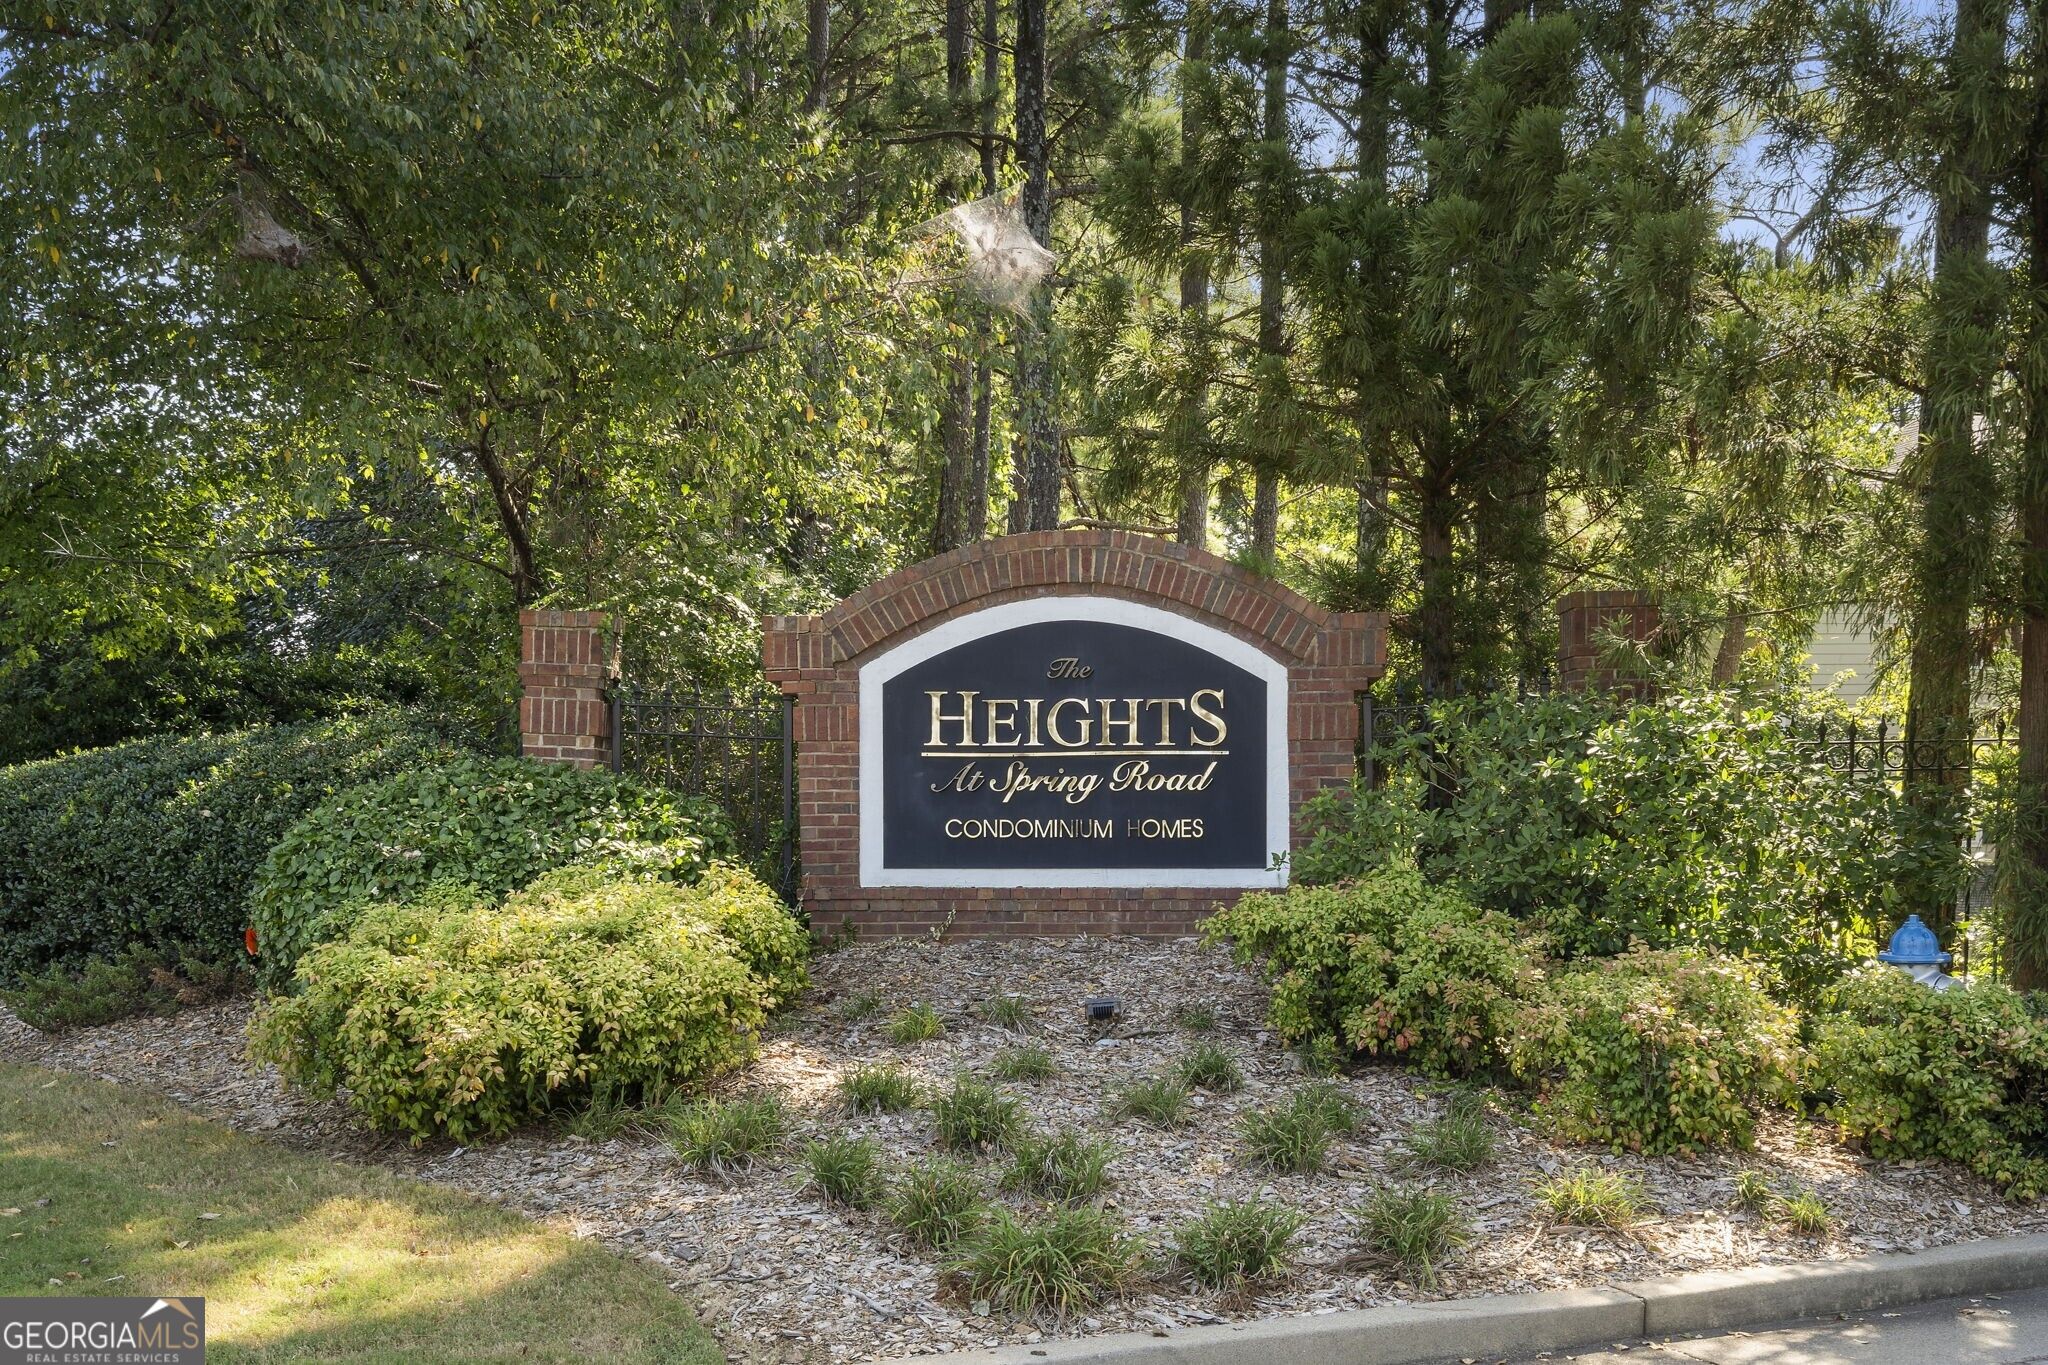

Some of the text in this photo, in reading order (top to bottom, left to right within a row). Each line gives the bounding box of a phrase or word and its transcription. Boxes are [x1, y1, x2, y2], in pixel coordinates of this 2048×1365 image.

[1046, 657, 1093, 679] The
[923, 688, 1228, 747] HEIGHTS
[930, 759, 1218, 804] At Spring Road
[944, 818, 1204, 839] CONDOMINIUM HOMES
